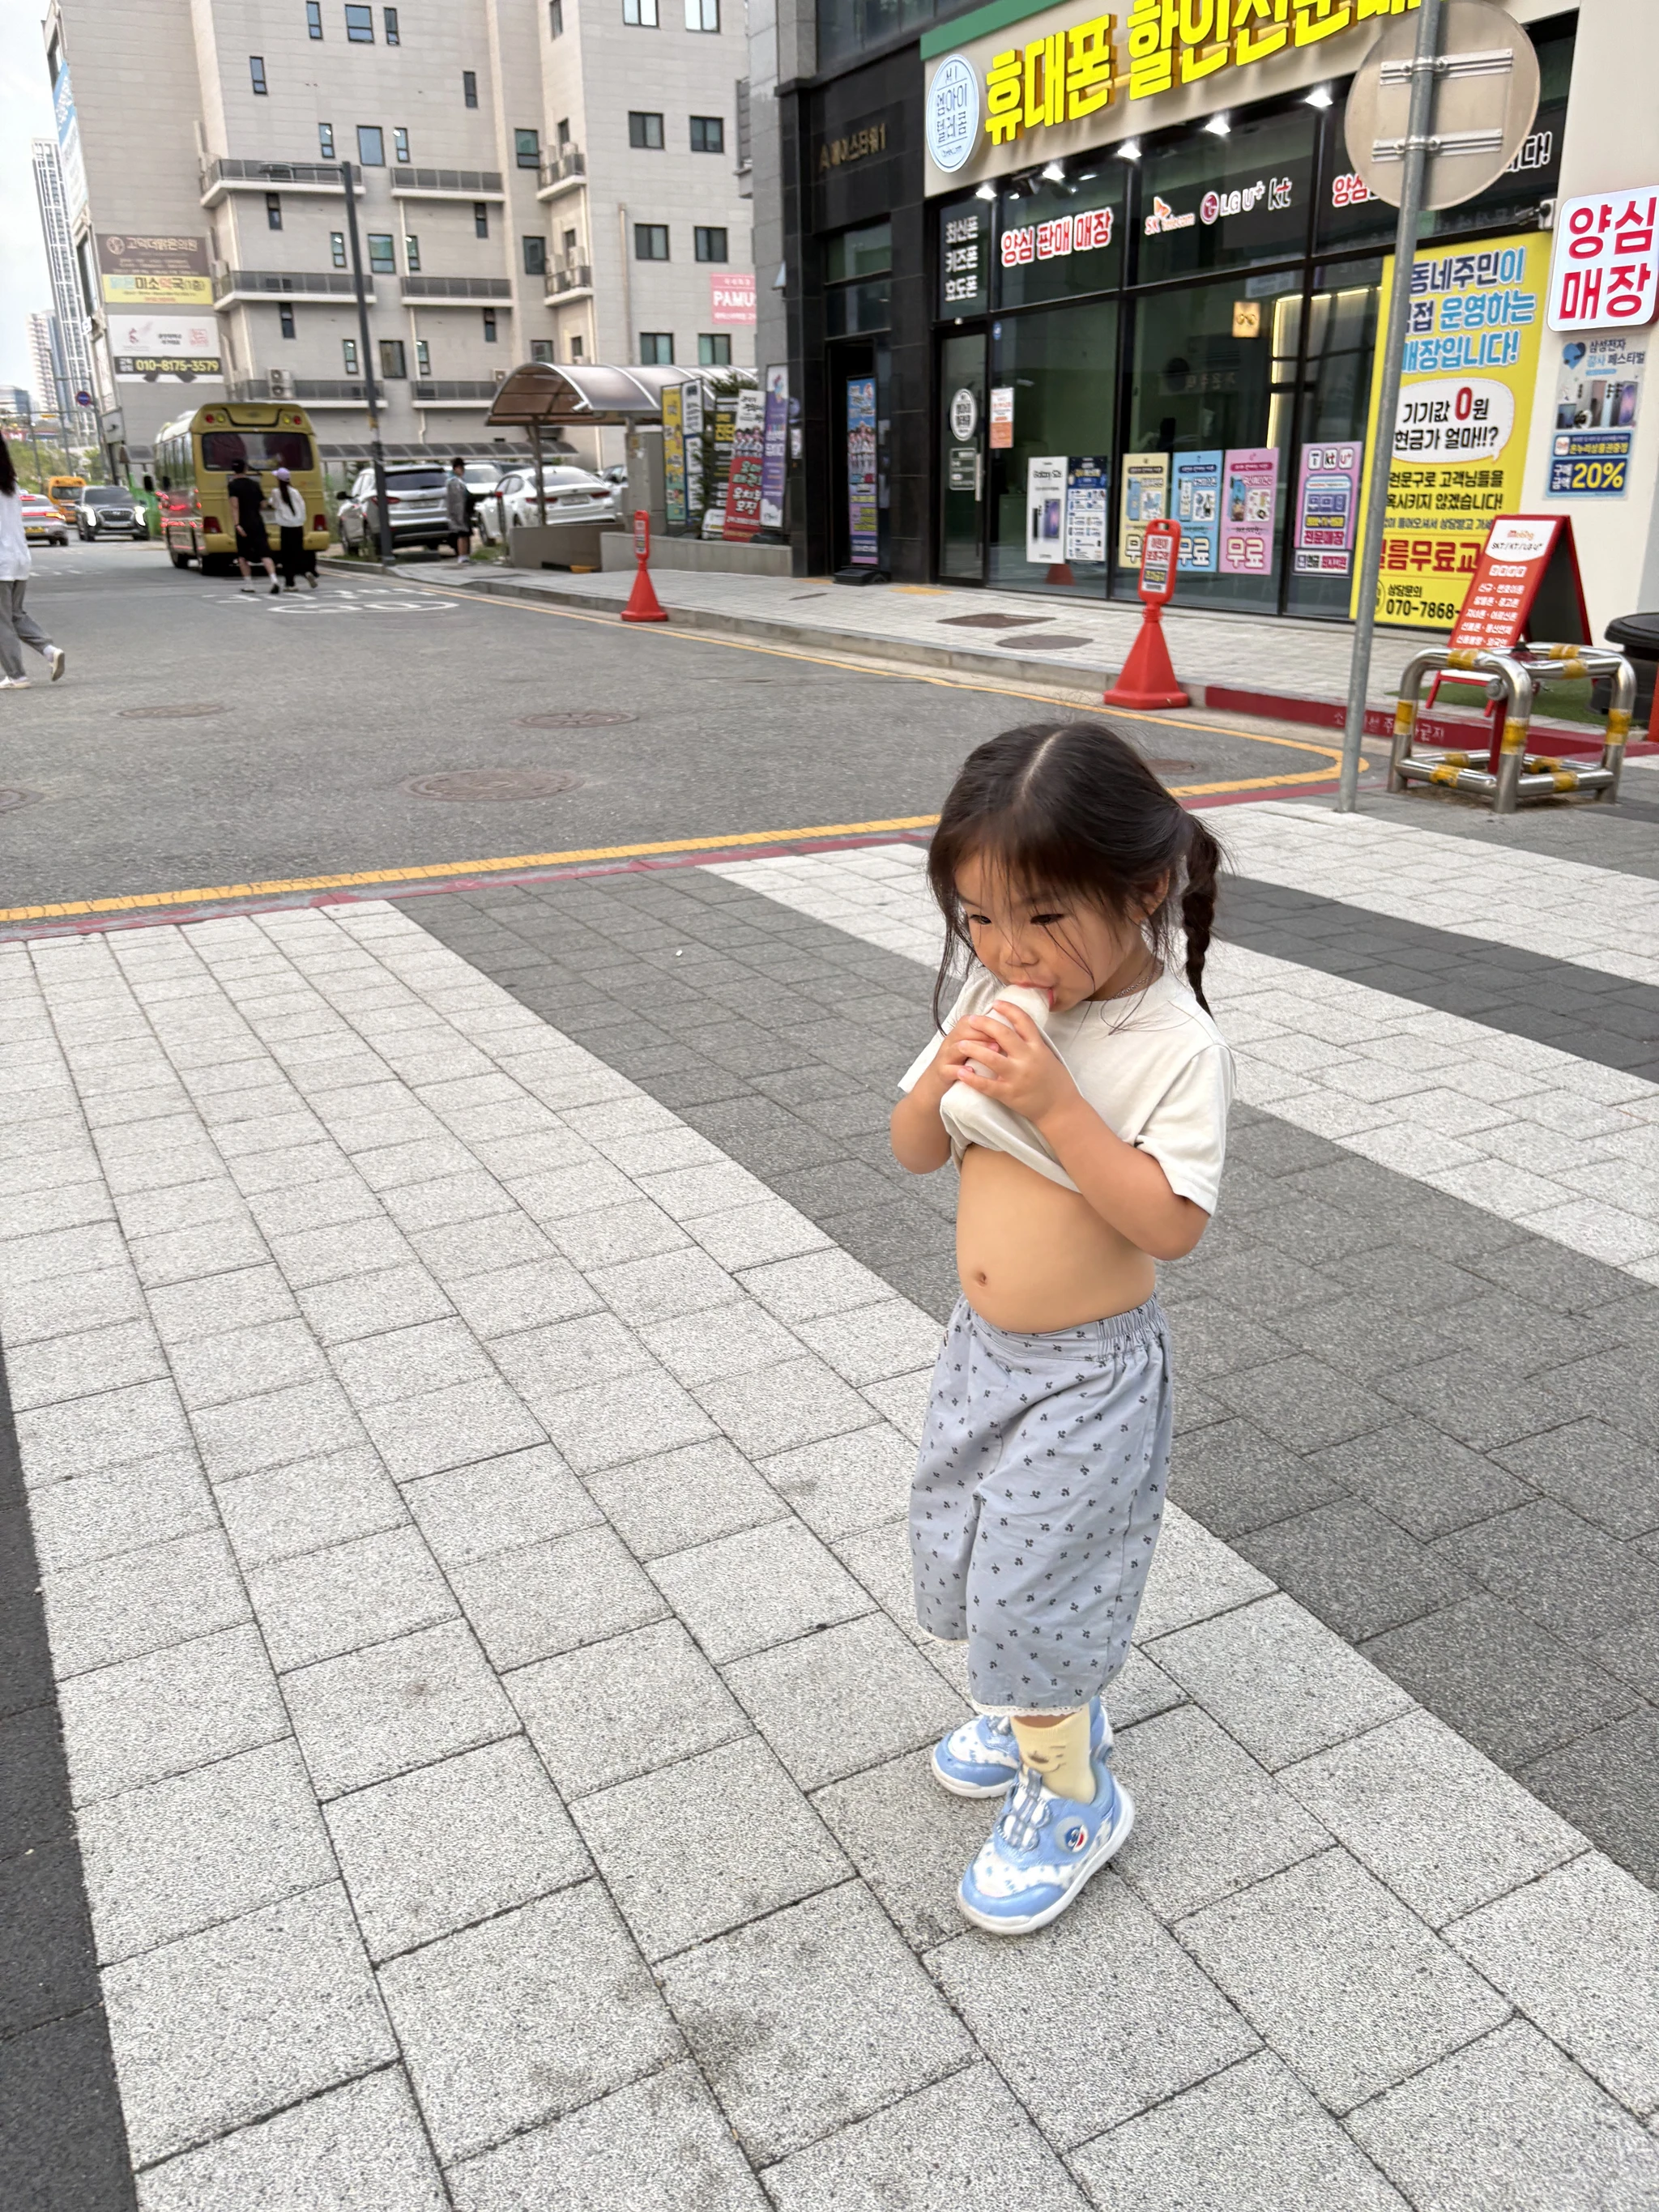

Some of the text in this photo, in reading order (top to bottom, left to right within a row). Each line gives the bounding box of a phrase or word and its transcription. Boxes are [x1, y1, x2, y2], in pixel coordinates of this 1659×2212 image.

[985, 13, 1111, 146] 휴대폰
[936, 83, 968, 117] 엠아이
[937, 111, 968, 144] 텔레콤
[1220, 181, 1265, 217] LG U+
[1268, 177, 1293, 211] kt
[945, 215, 979, 244] 최신폰
[1001, 207, 1114, 267] 양심 판매 매장
[1568, 196, 1657, 259] 양심
[945, 245, 979, 272] 키즈폰
[713, 290, 757, 307] PAMU
[945, 275, 978, 302] 효도폰
[1558, 262, 1652, 320] 매장
[1406, 288, 1537, 335] 접 운영하는
[1589, 338, 1627, 353] 삼성전자
[1608, 352, 1645, 365] 페스티벌
[135, 359, 220, 372] 010-8175-3579
[1403, 386, 1490, 423] 기기값 0원
[1394, 424, 1499, 451] 현금가 얼마!!?
[1439, 470, 1503, 488] 고객님들을
[1572, 462, 1626, 489] 20%
[1435, 492, 1503, 510] 않겠습니다!
[1125, 534, 1143, 565] 무
[1178, 536, 1211, 567] 무료
[1226, 536, 1265, 569] 무료
[1388, 583, 1422, 599] 상담문의
[1384, 716, 1444, 743] 주금지
